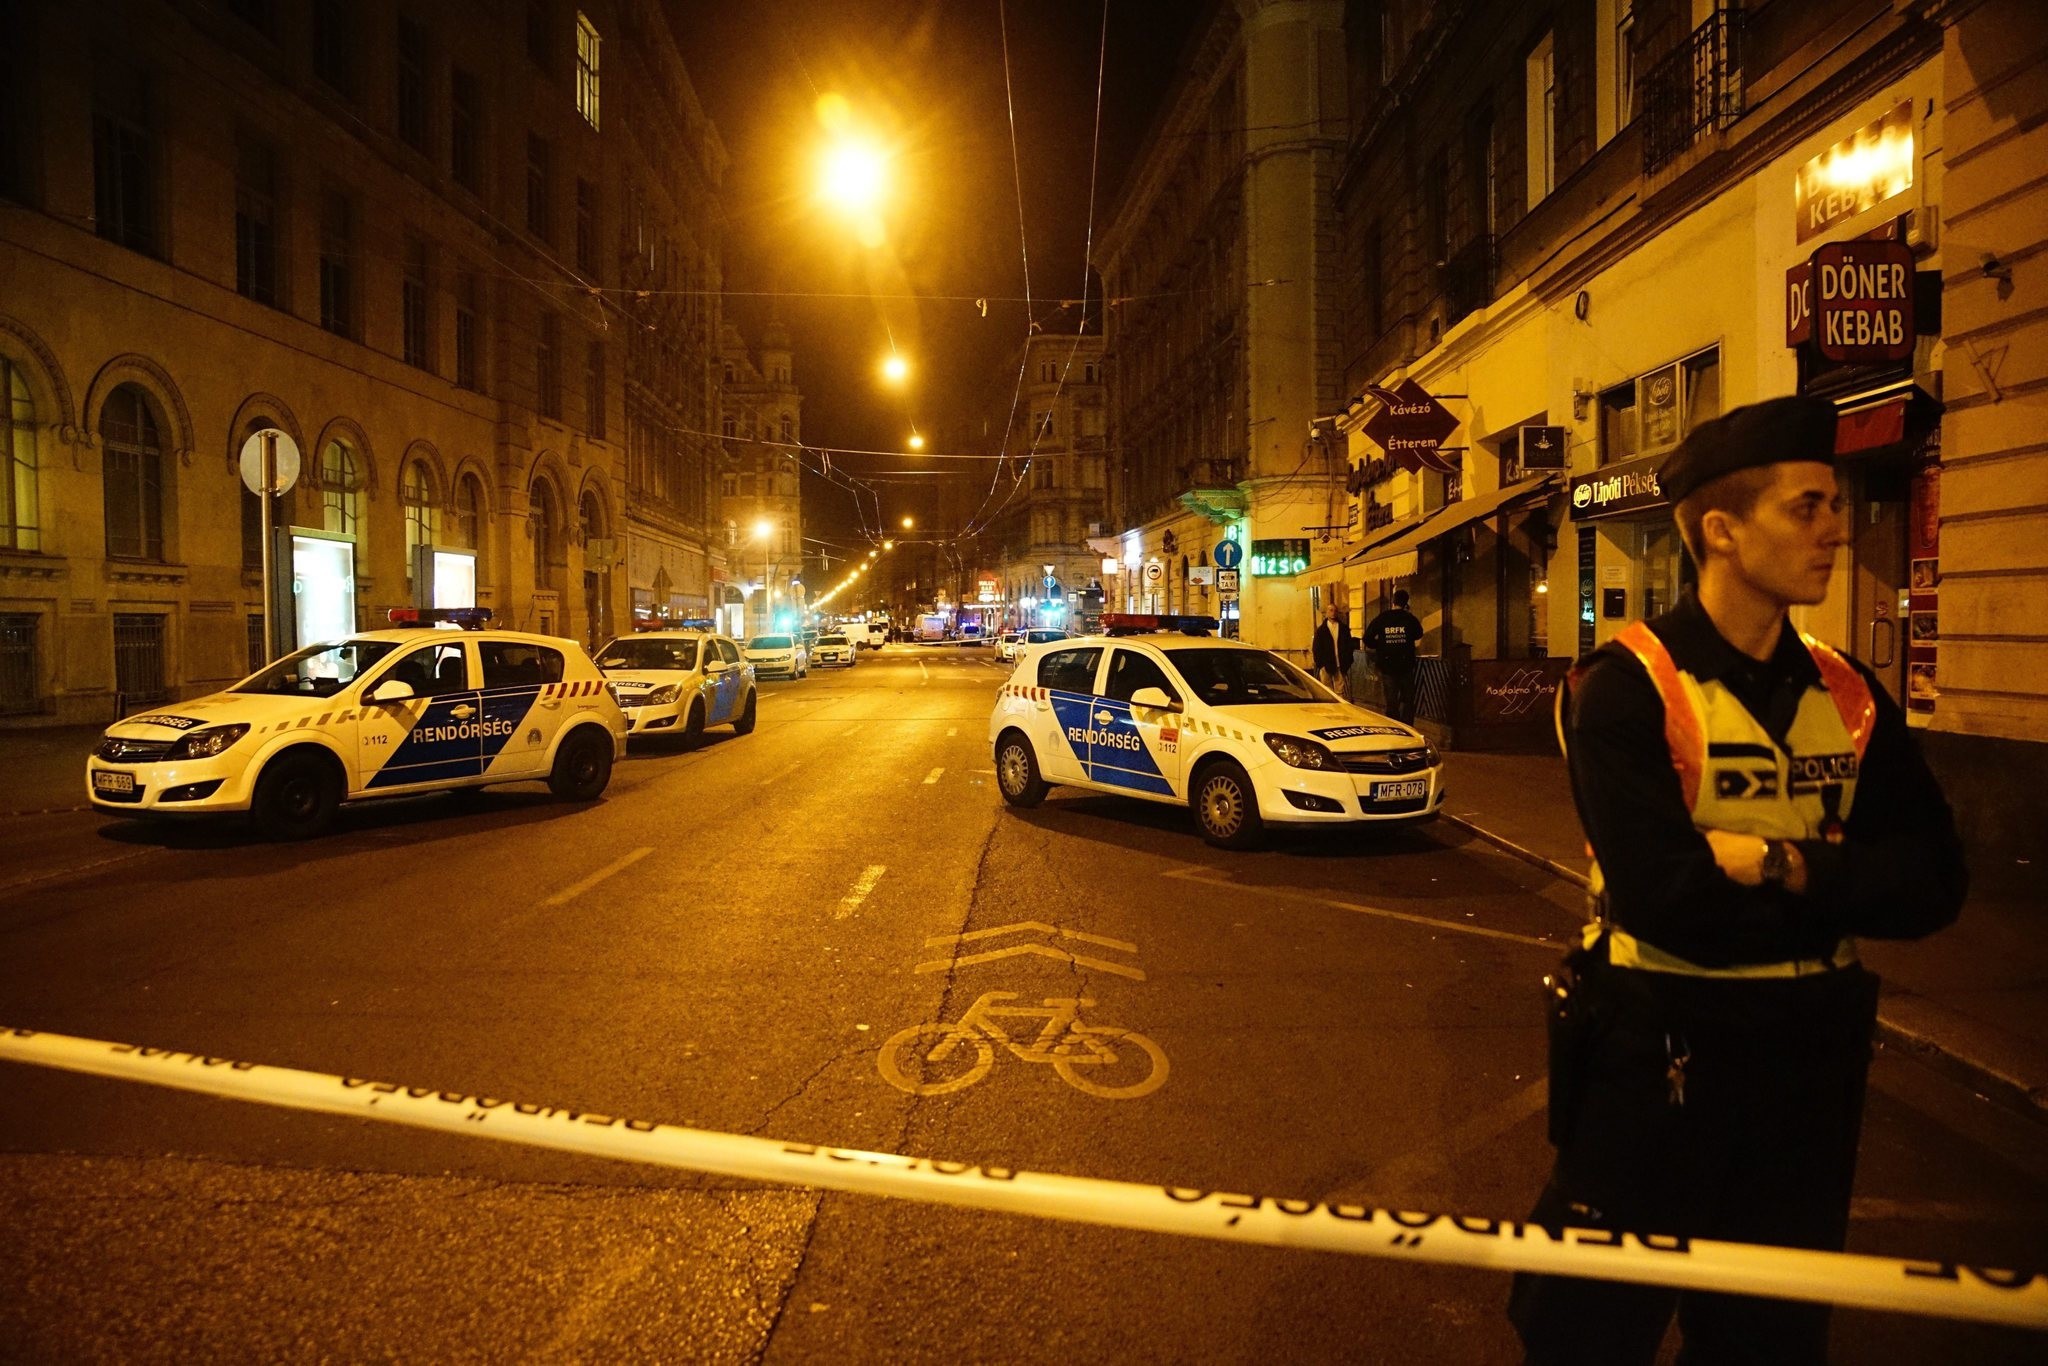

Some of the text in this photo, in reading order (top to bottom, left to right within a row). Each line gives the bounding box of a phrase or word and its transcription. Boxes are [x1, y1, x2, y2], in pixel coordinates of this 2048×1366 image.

[1821, 256, 1906, 299] DÖNER
[1826, 309, 1904, 345] KEBAB
[1389, 402, 1431, 416] Kávézó
[1388, 435, 1438, 451] Étterem
[1592, 476, 1622, 506] Lipóti
[1622, 466, 1661, 498] Pékség
[1384, 626, 1406, 634] BRFK
[1486, 684, 1530, 696] Magdalena
[413, 718, 513, 744] RENDŐRSÉG
[1068, 727, 1140, 751] RENDŐRSÉG
[372, 735, 388, 745] 112
[1164, 743, 1177, 753] 112
[1792, 757, 1856, 779] POLICE
[1380, 782, 1424, 798] MFR-078
